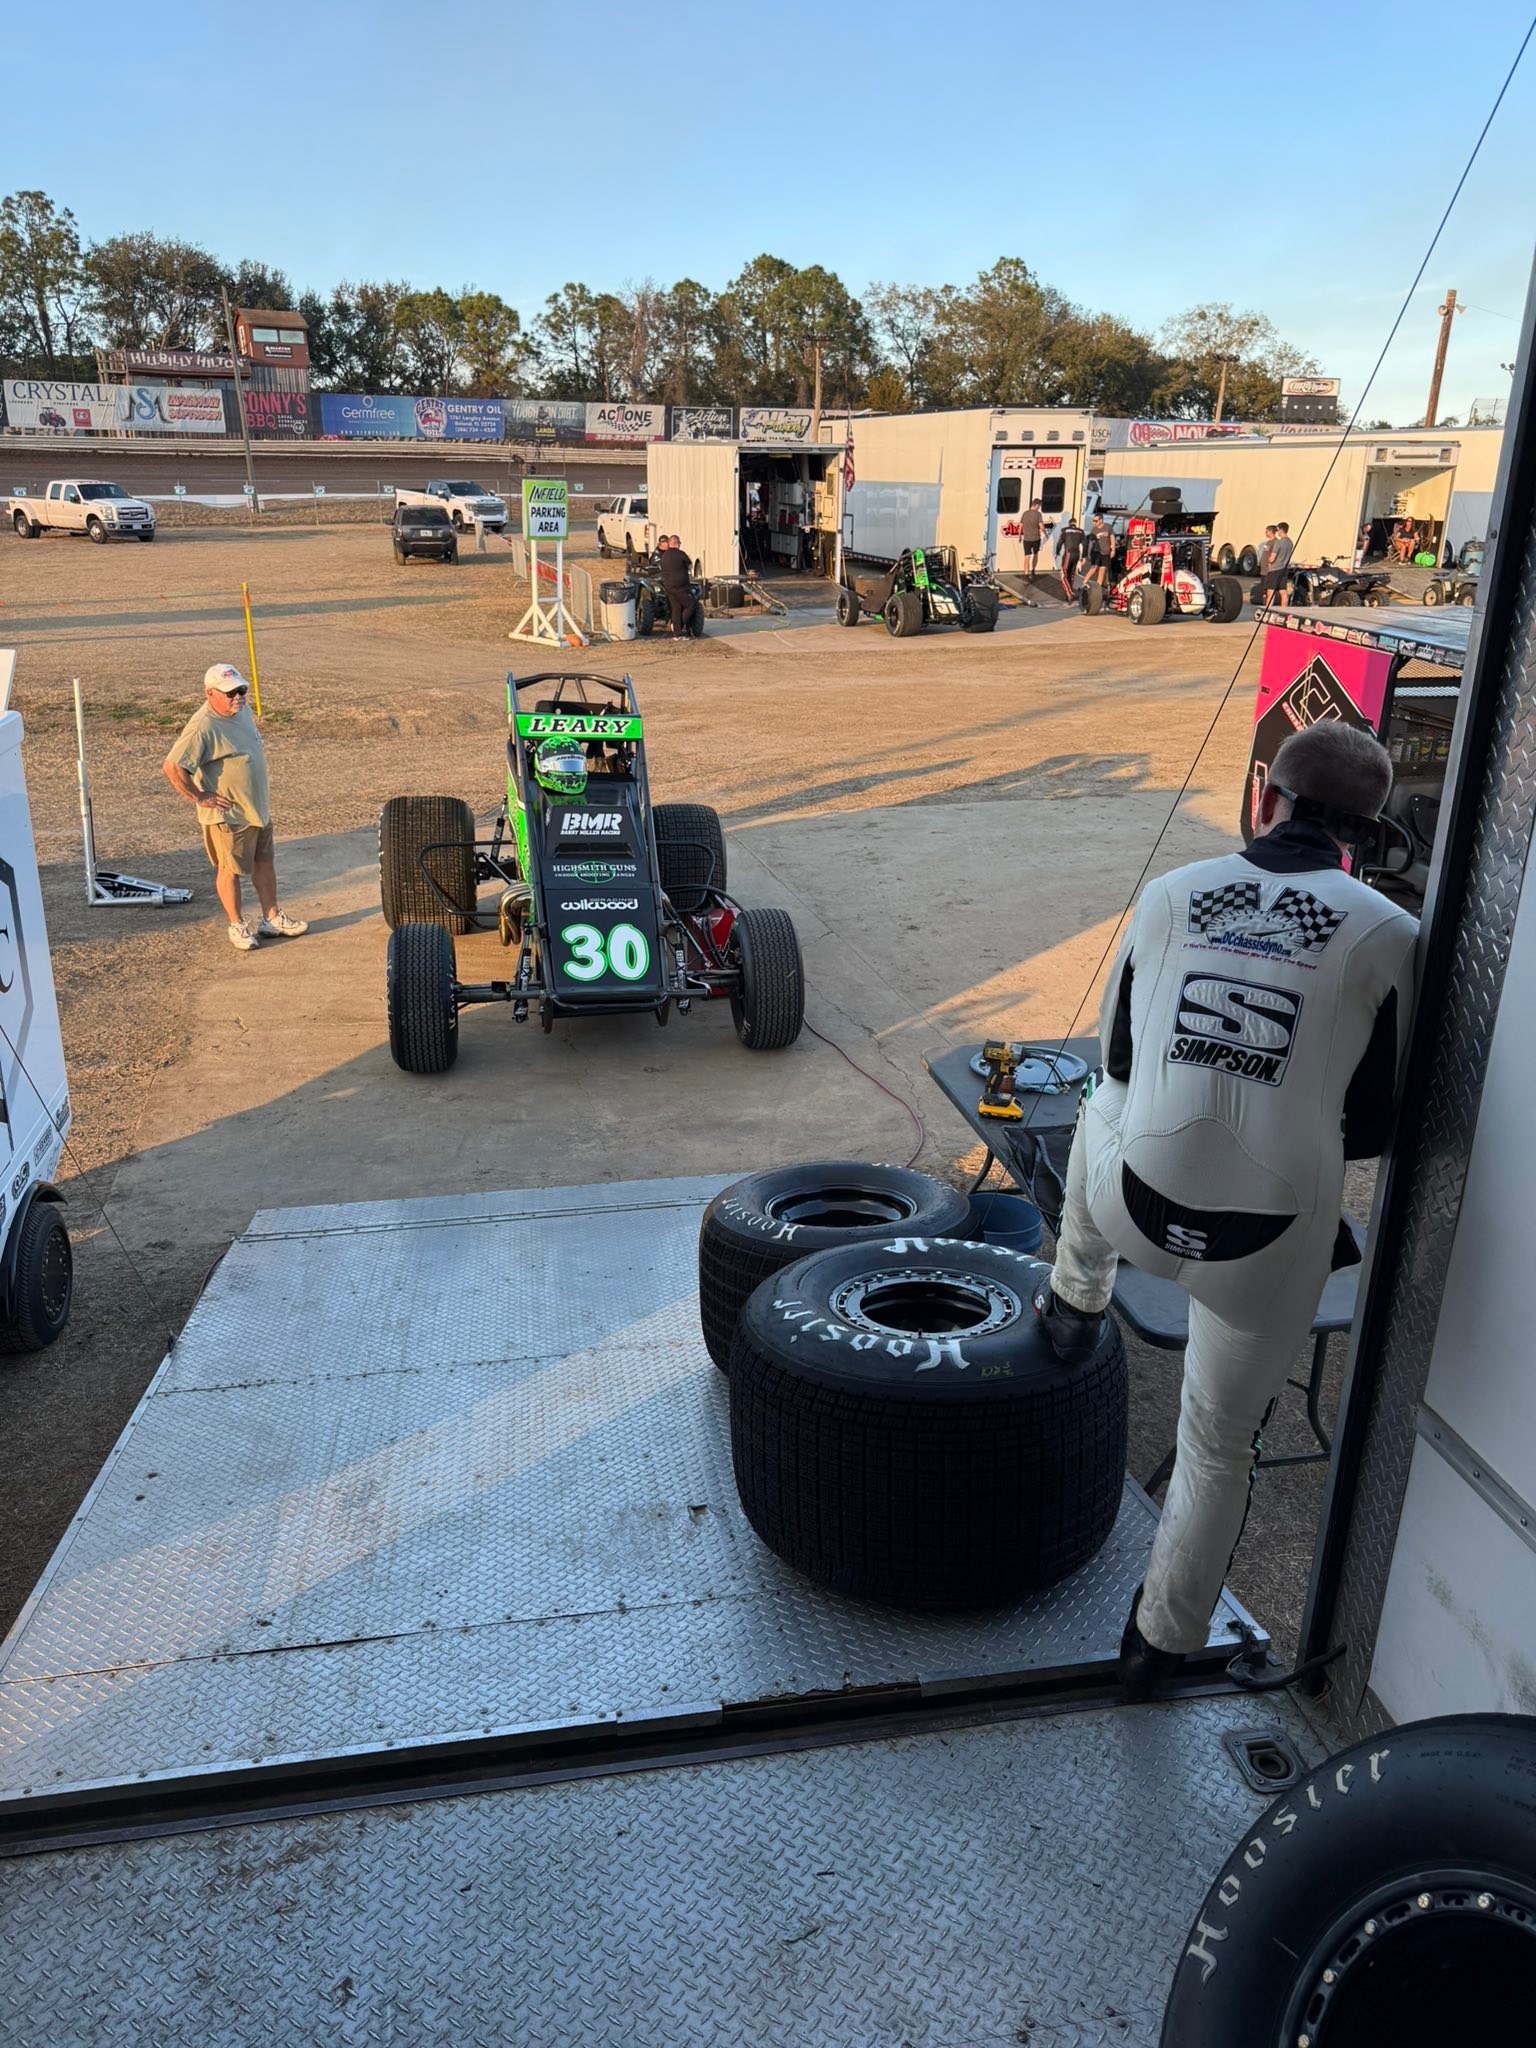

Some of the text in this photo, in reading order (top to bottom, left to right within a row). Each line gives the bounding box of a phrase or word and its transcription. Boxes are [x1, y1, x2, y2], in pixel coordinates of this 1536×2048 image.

[130, 352, 193, 367] HILLBILLY
[13, 381, 108, 402] CRYSTAL
[242, 391, 307, 415] SONNY'S
[447, 404, 502, 415] GENTRY OIL
[341, 406, 396, 419] Germfree
[687, 409, 728, 423] Action
[751, 409, 811, 427] Allen
[247, 413, 278, 430] BBQ
[1091, 428, 1112, 438] USCH
[529, 485, 566, 502] INFIELD
[530, 506, 566, 518] PARKING
[537, 521, 559, 532] AREA
[529, 718, 630, 734] LEARY
[561, 813, 622, 830] BMR
[553, 864, 637, 872] HIGHSMITH GUNS
[561, 899, 638, 911] wilwood
[561, 924, 649, 981] 30
[1187, 1749, 1391, 1986] Hoosier
